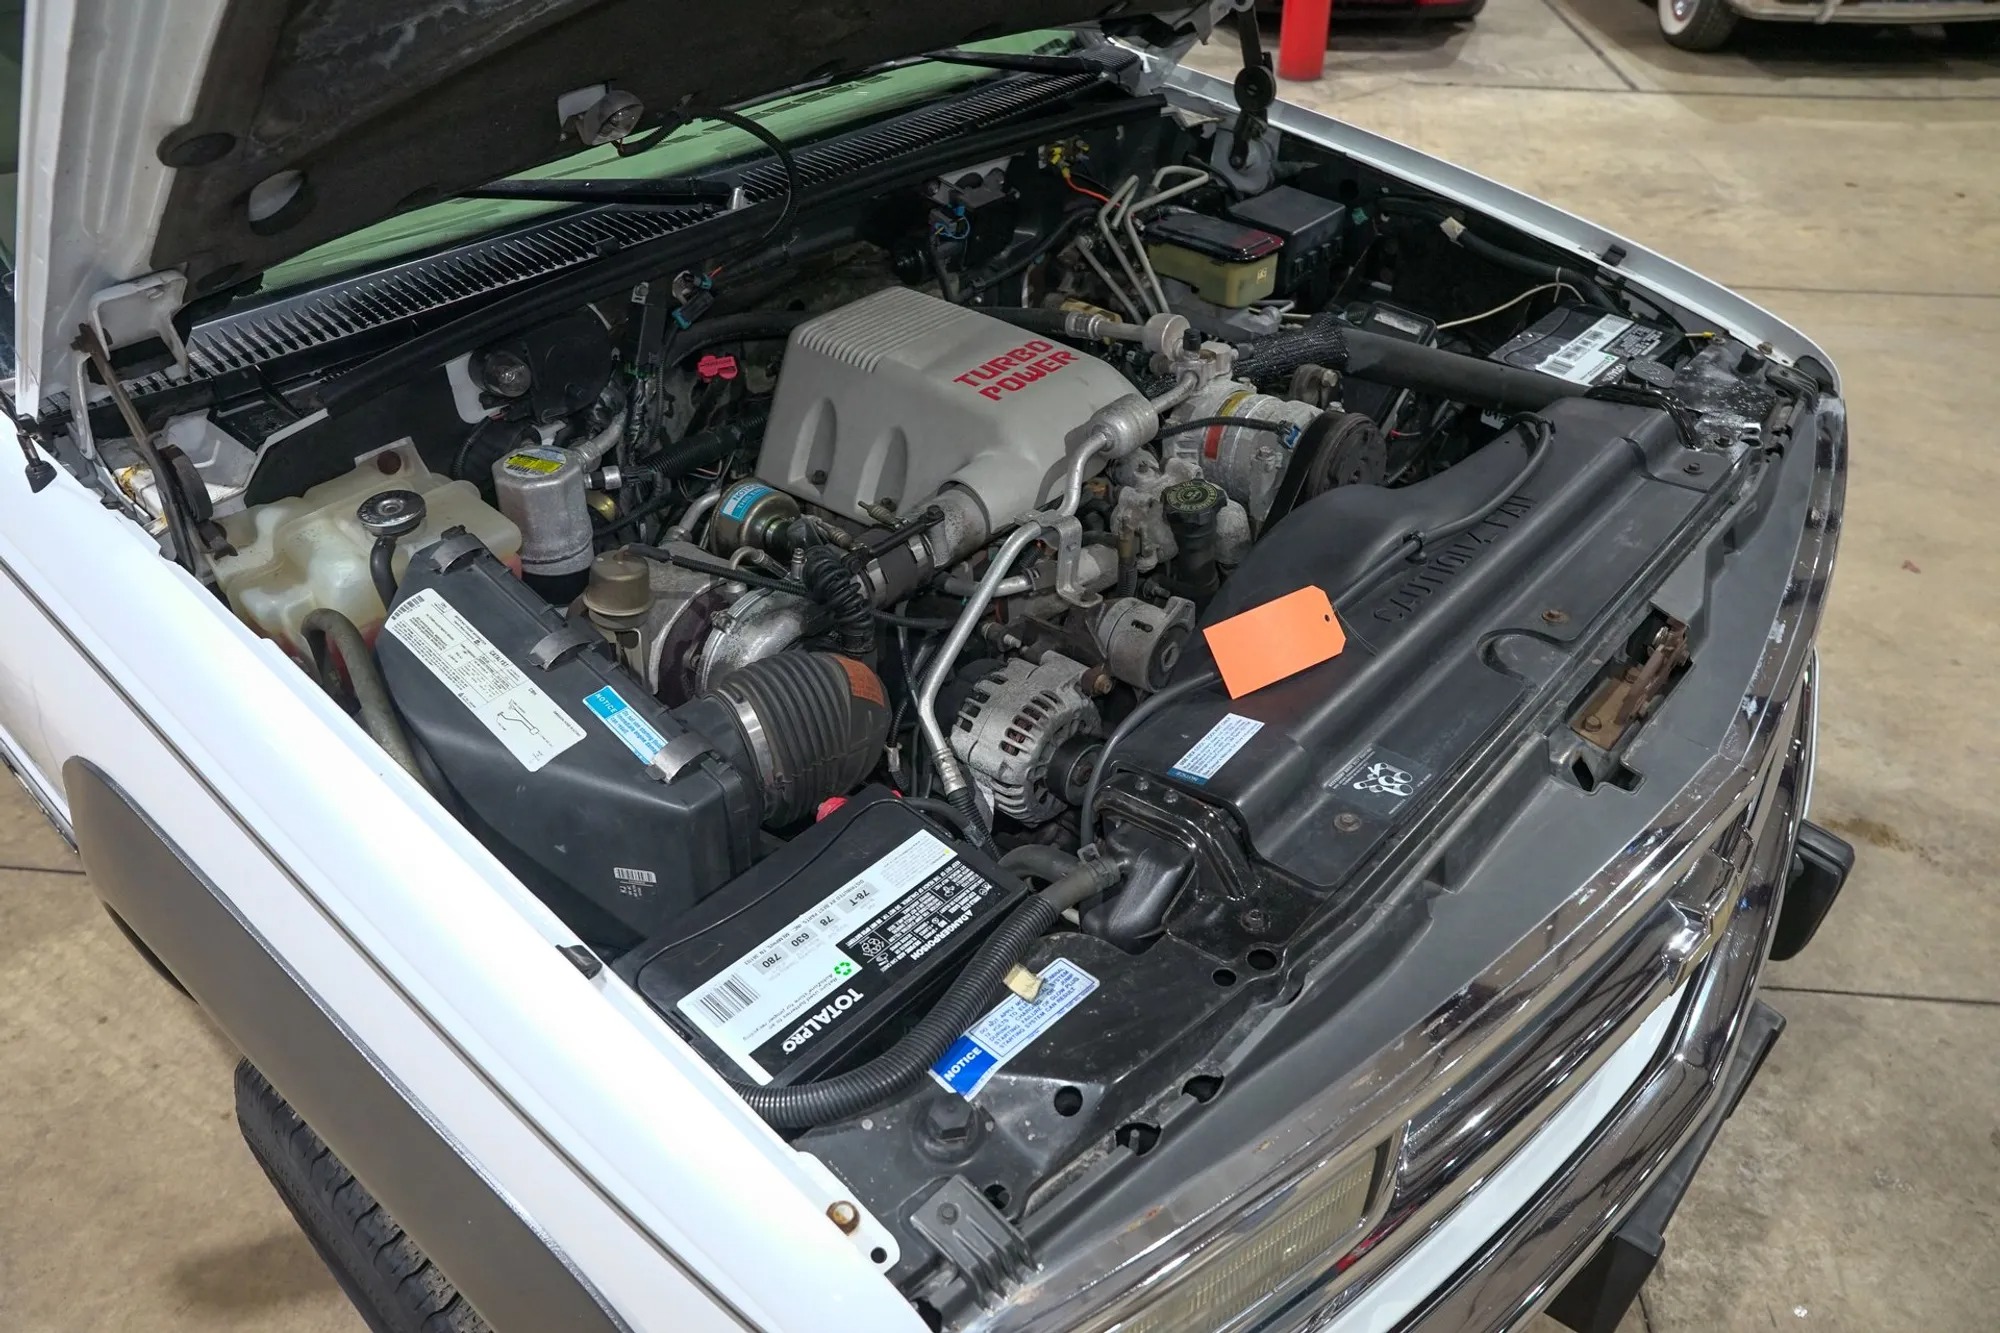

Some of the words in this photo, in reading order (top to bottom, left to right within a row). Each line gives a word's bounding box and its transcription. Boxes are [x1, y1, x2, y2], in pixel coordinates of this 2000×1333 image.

[953, 339, 1054, 387] TURBO
[979, 349, 1079, 401] POWER
[594, 692, 617, 713] NOTICE
[846, 888, 870, 906] 78-T
[818, 914, 834, 926] 78
[789, 932, 810, 947] 630
[760, 952, 782, 968] 780
[776, 986, 864, 1054] TOTALPRO
[999, 1026, 1025, 1049] STARTING
[1024, 1010, 1045, 1028] SYSTEM
[1044, 1001, 1057, 1012] CAN
[1055, 986, 1075, 1003] RESULT
[1000, 1005, 1014, 1018] APPLY
[988, 1023, 1010, 1042] DURING
[993, 1023, 1020, 1046] STARTING
[1020, 1006, 1041, 1024] FAILURE
[942, 1045, 983, 1081] NOTICE
